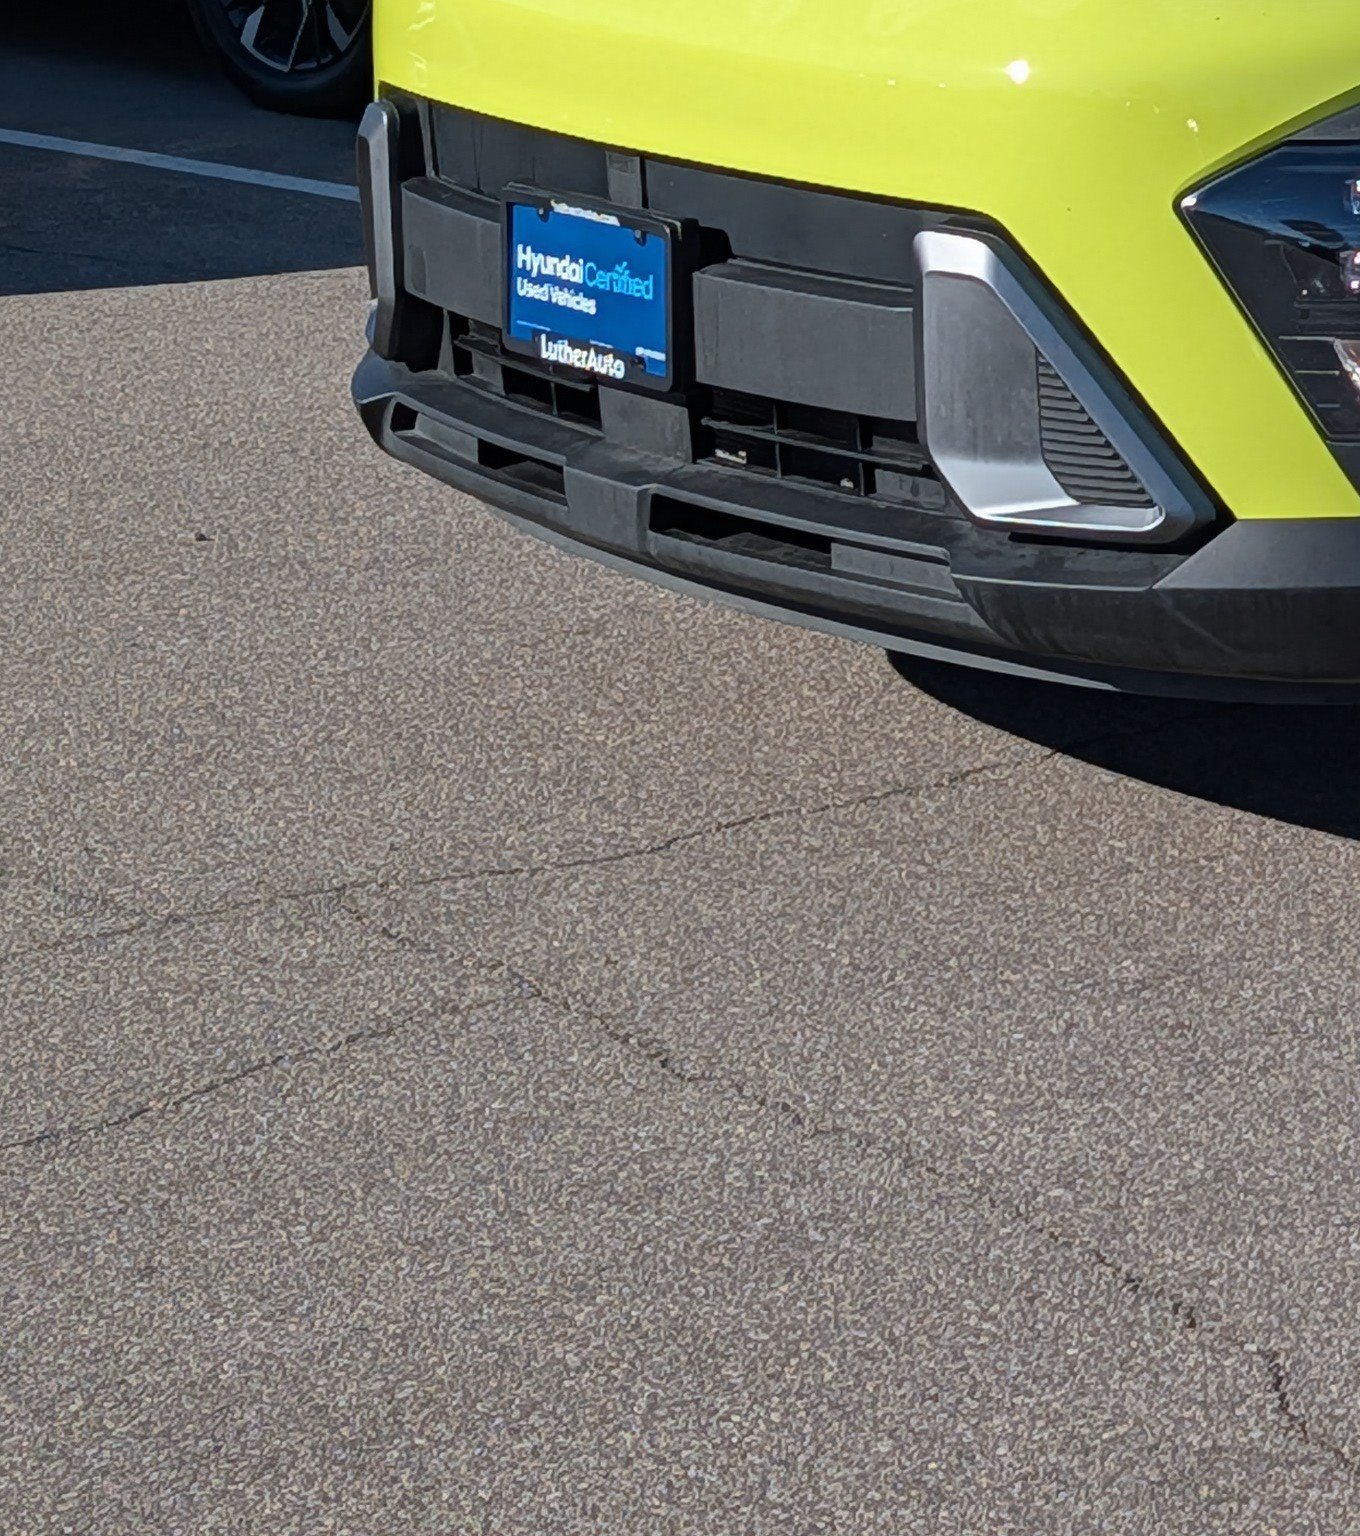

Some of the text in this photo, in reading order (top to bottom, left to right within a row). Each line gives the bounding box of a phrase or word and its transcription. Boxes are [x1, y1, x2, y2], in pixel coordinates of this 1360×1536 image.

[516, 243, 654, 300] Hyundai Certified
[516, 277, 597, 315] Used Vehicles
